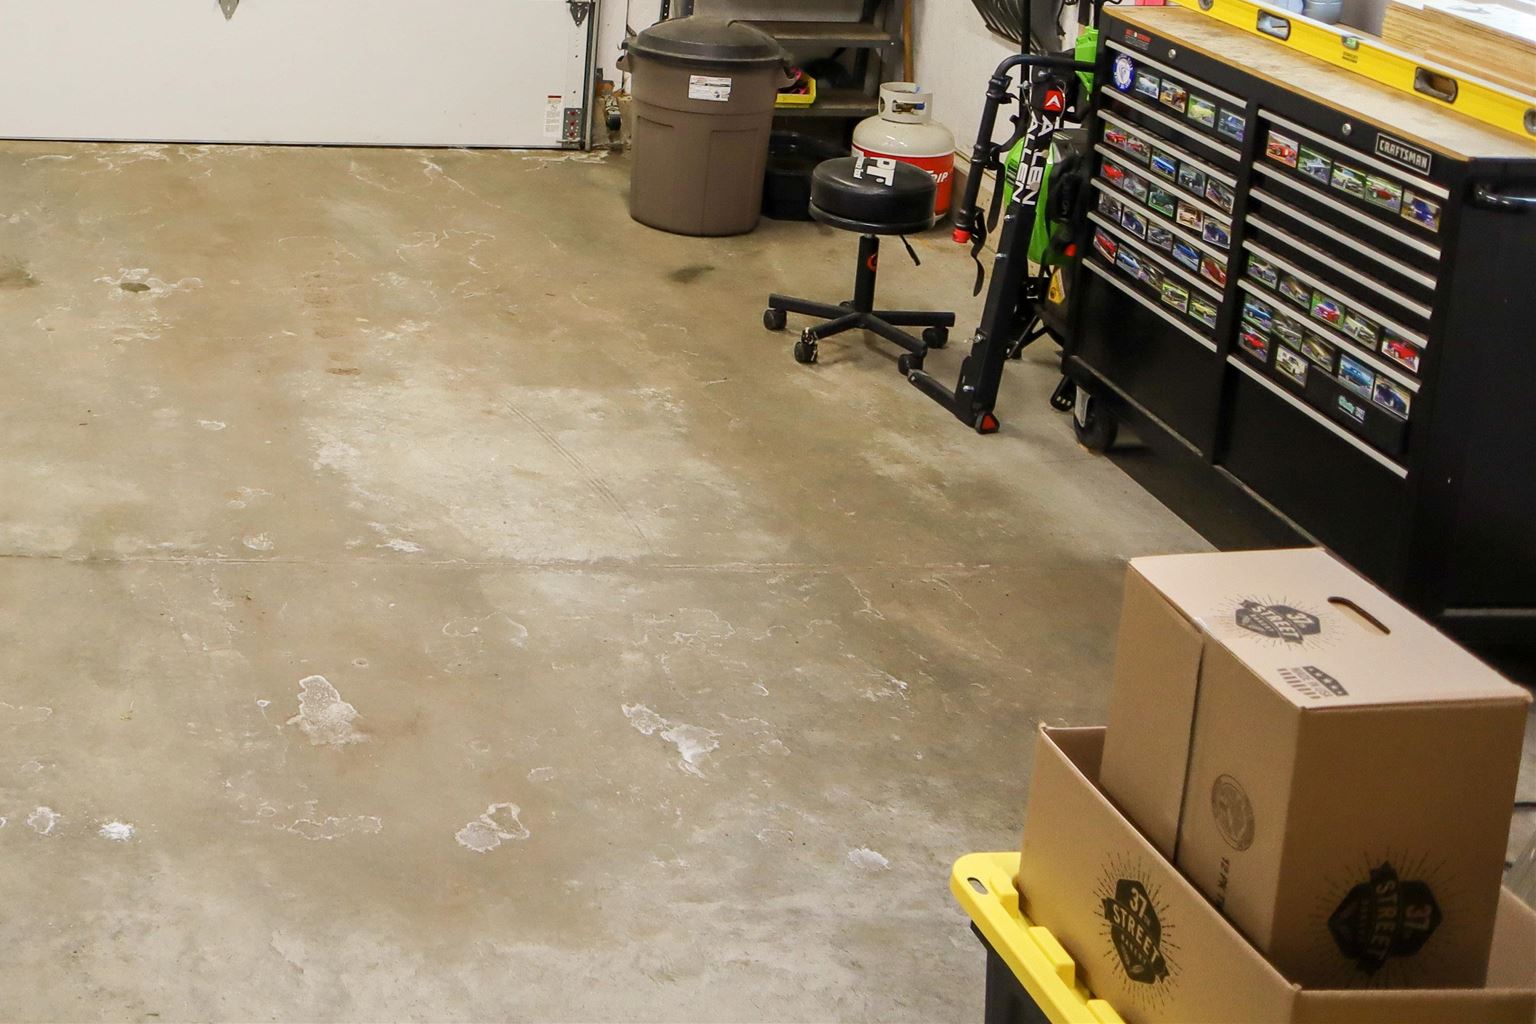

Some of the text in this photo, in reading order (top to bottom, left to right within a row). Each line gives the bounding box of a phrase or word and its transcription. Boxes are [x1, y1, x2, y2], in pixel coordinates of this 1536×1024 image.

[1011, 109, 1039, 204] ALLEN
[1022, 114, 1054, 206] ALEN
[1378, 139, 1429, 170] CRAFTSMAN
[1251, 604, 1301, 640] STREET
[1112, 903, 1161, 963] STREET
[1367, 879, 1399, 958] STREET
